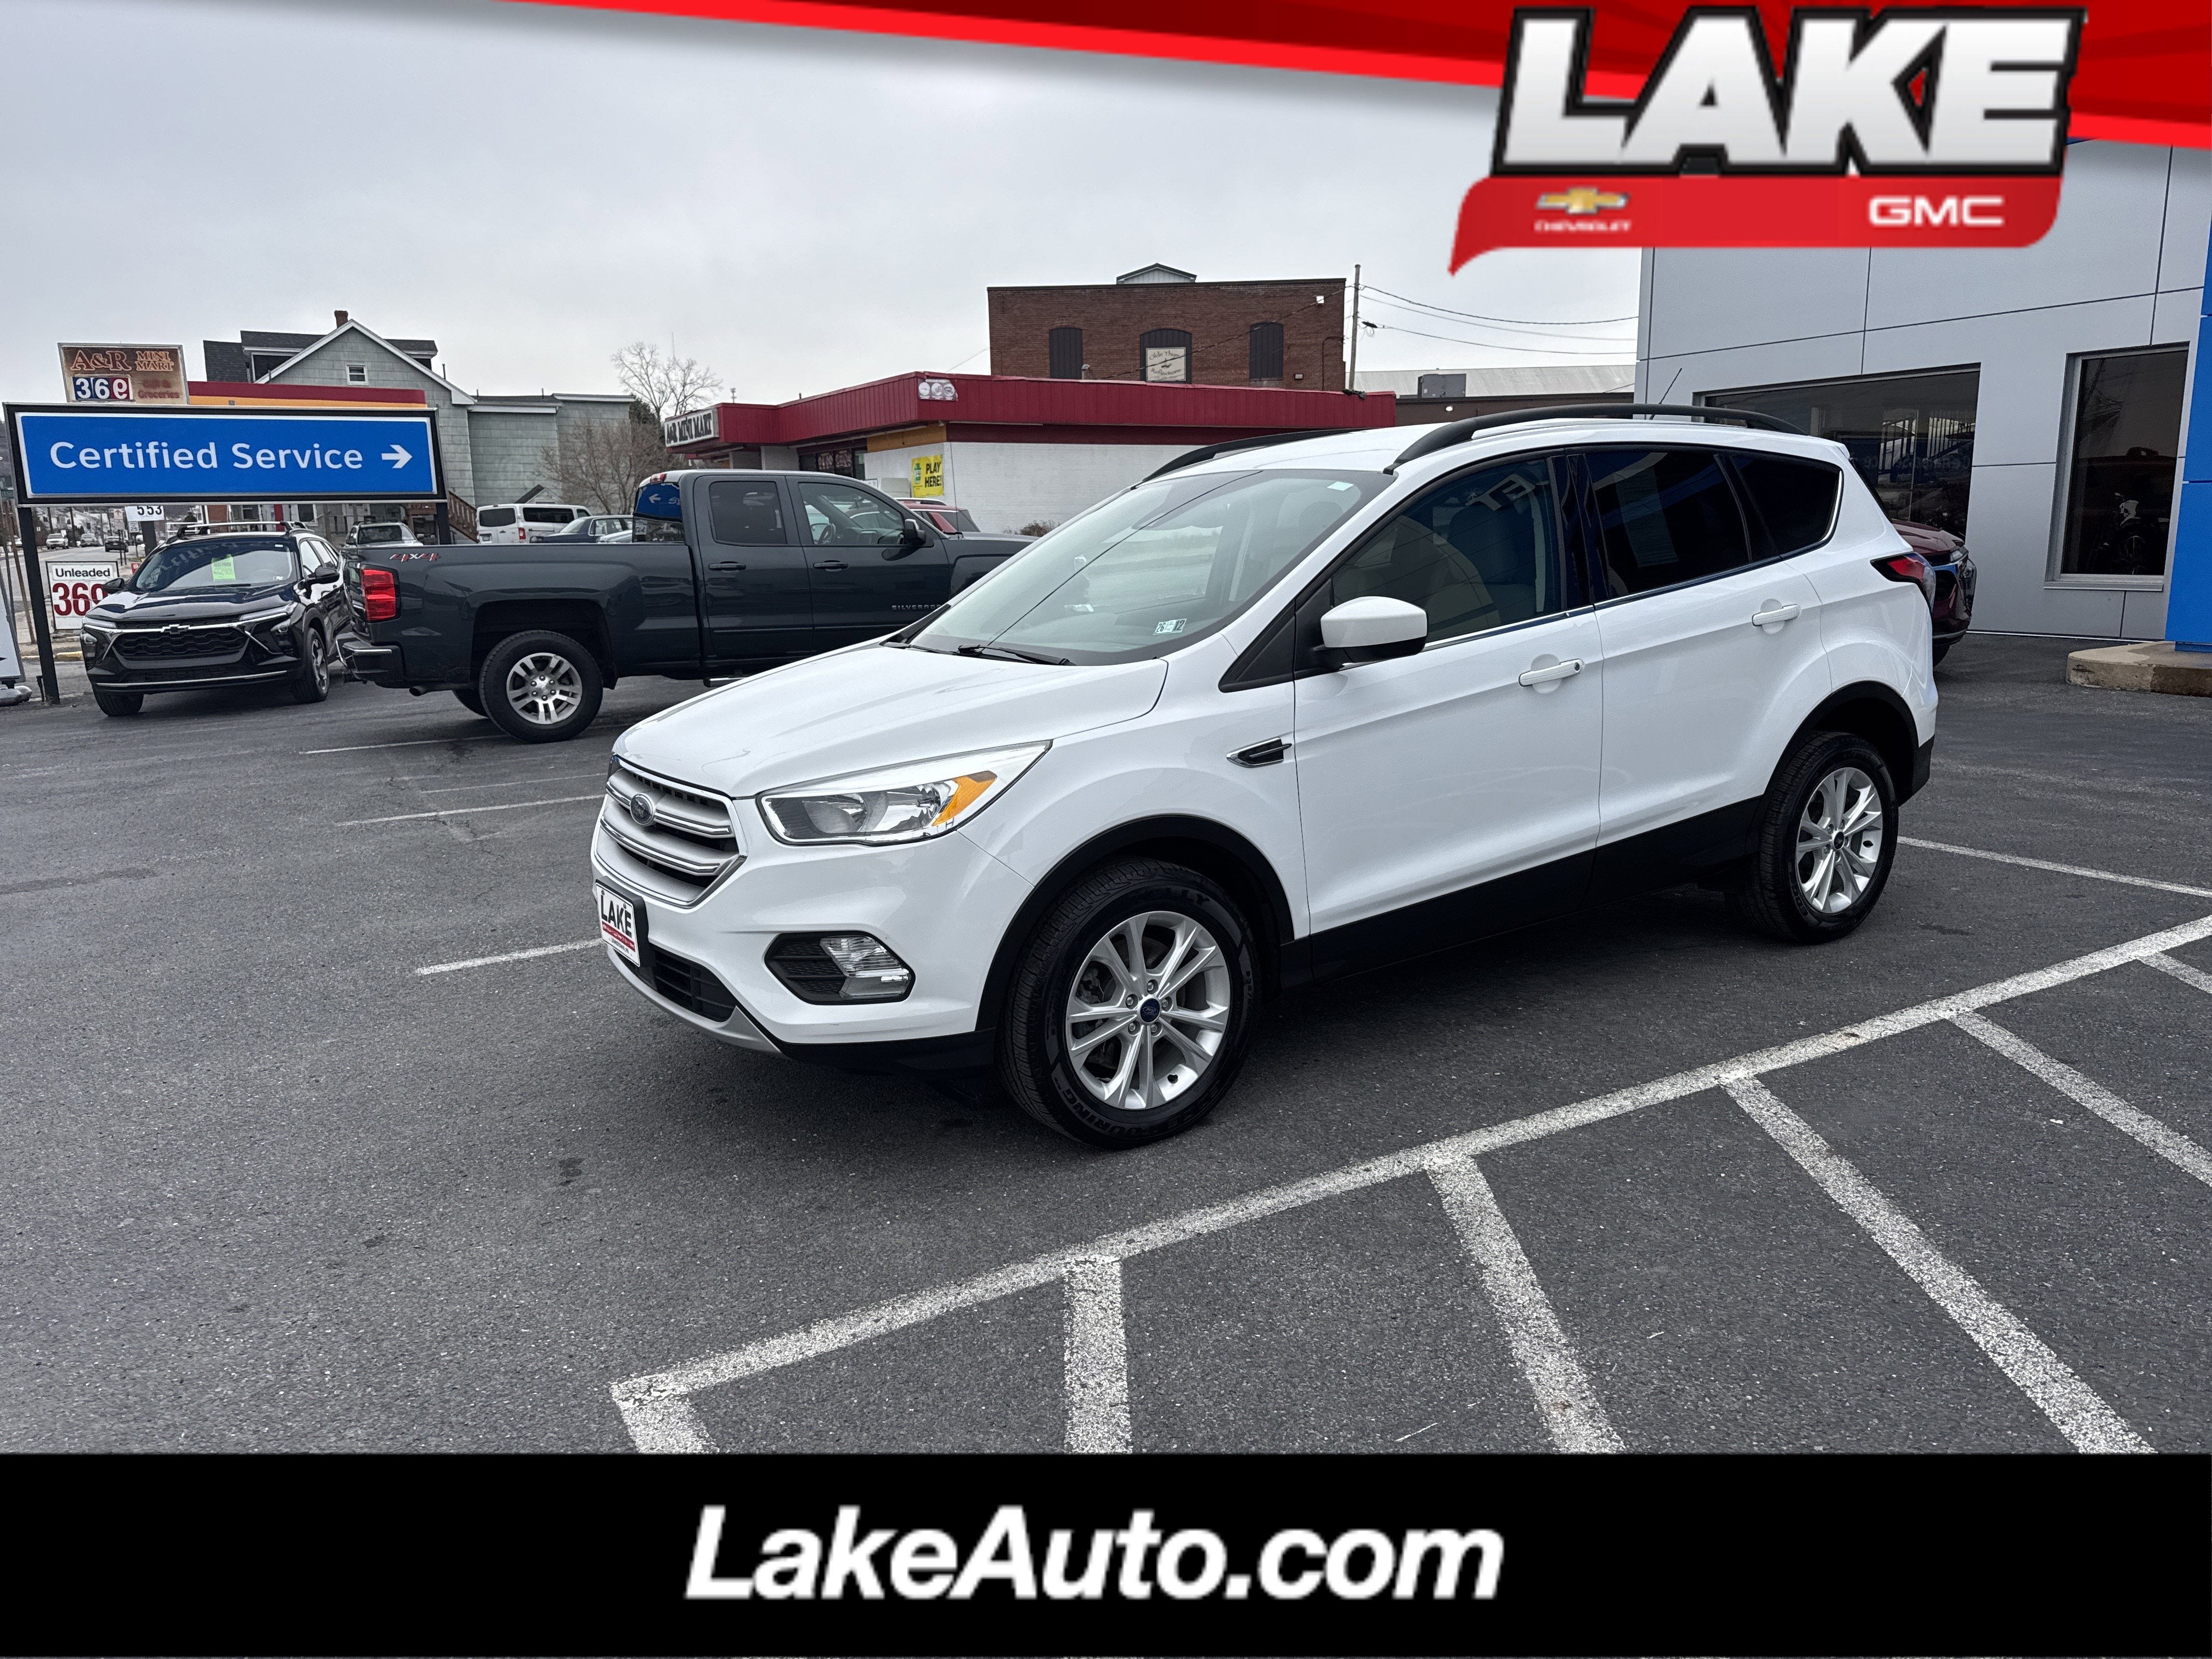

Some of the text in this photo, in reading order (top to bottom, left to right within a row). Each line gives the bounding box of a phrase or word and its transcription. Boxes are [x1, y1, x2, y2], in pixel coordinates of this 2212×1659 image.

[70, 350, 132, 371] A&R
[136, 351, 171, 361] MINI
[135, 361, 174, 371] MART
[138, 390, 180, 398] Groceries
[50, 442, 363, 469] Certified Service
[926, 461, 941, 475] PLAY
[924, 475, 942, 488] HERE!
[55, 568, 111, 577] Unleaded
[1172, 619, 1186, 631] 12
[601, 894, 632, 939] LAKE
